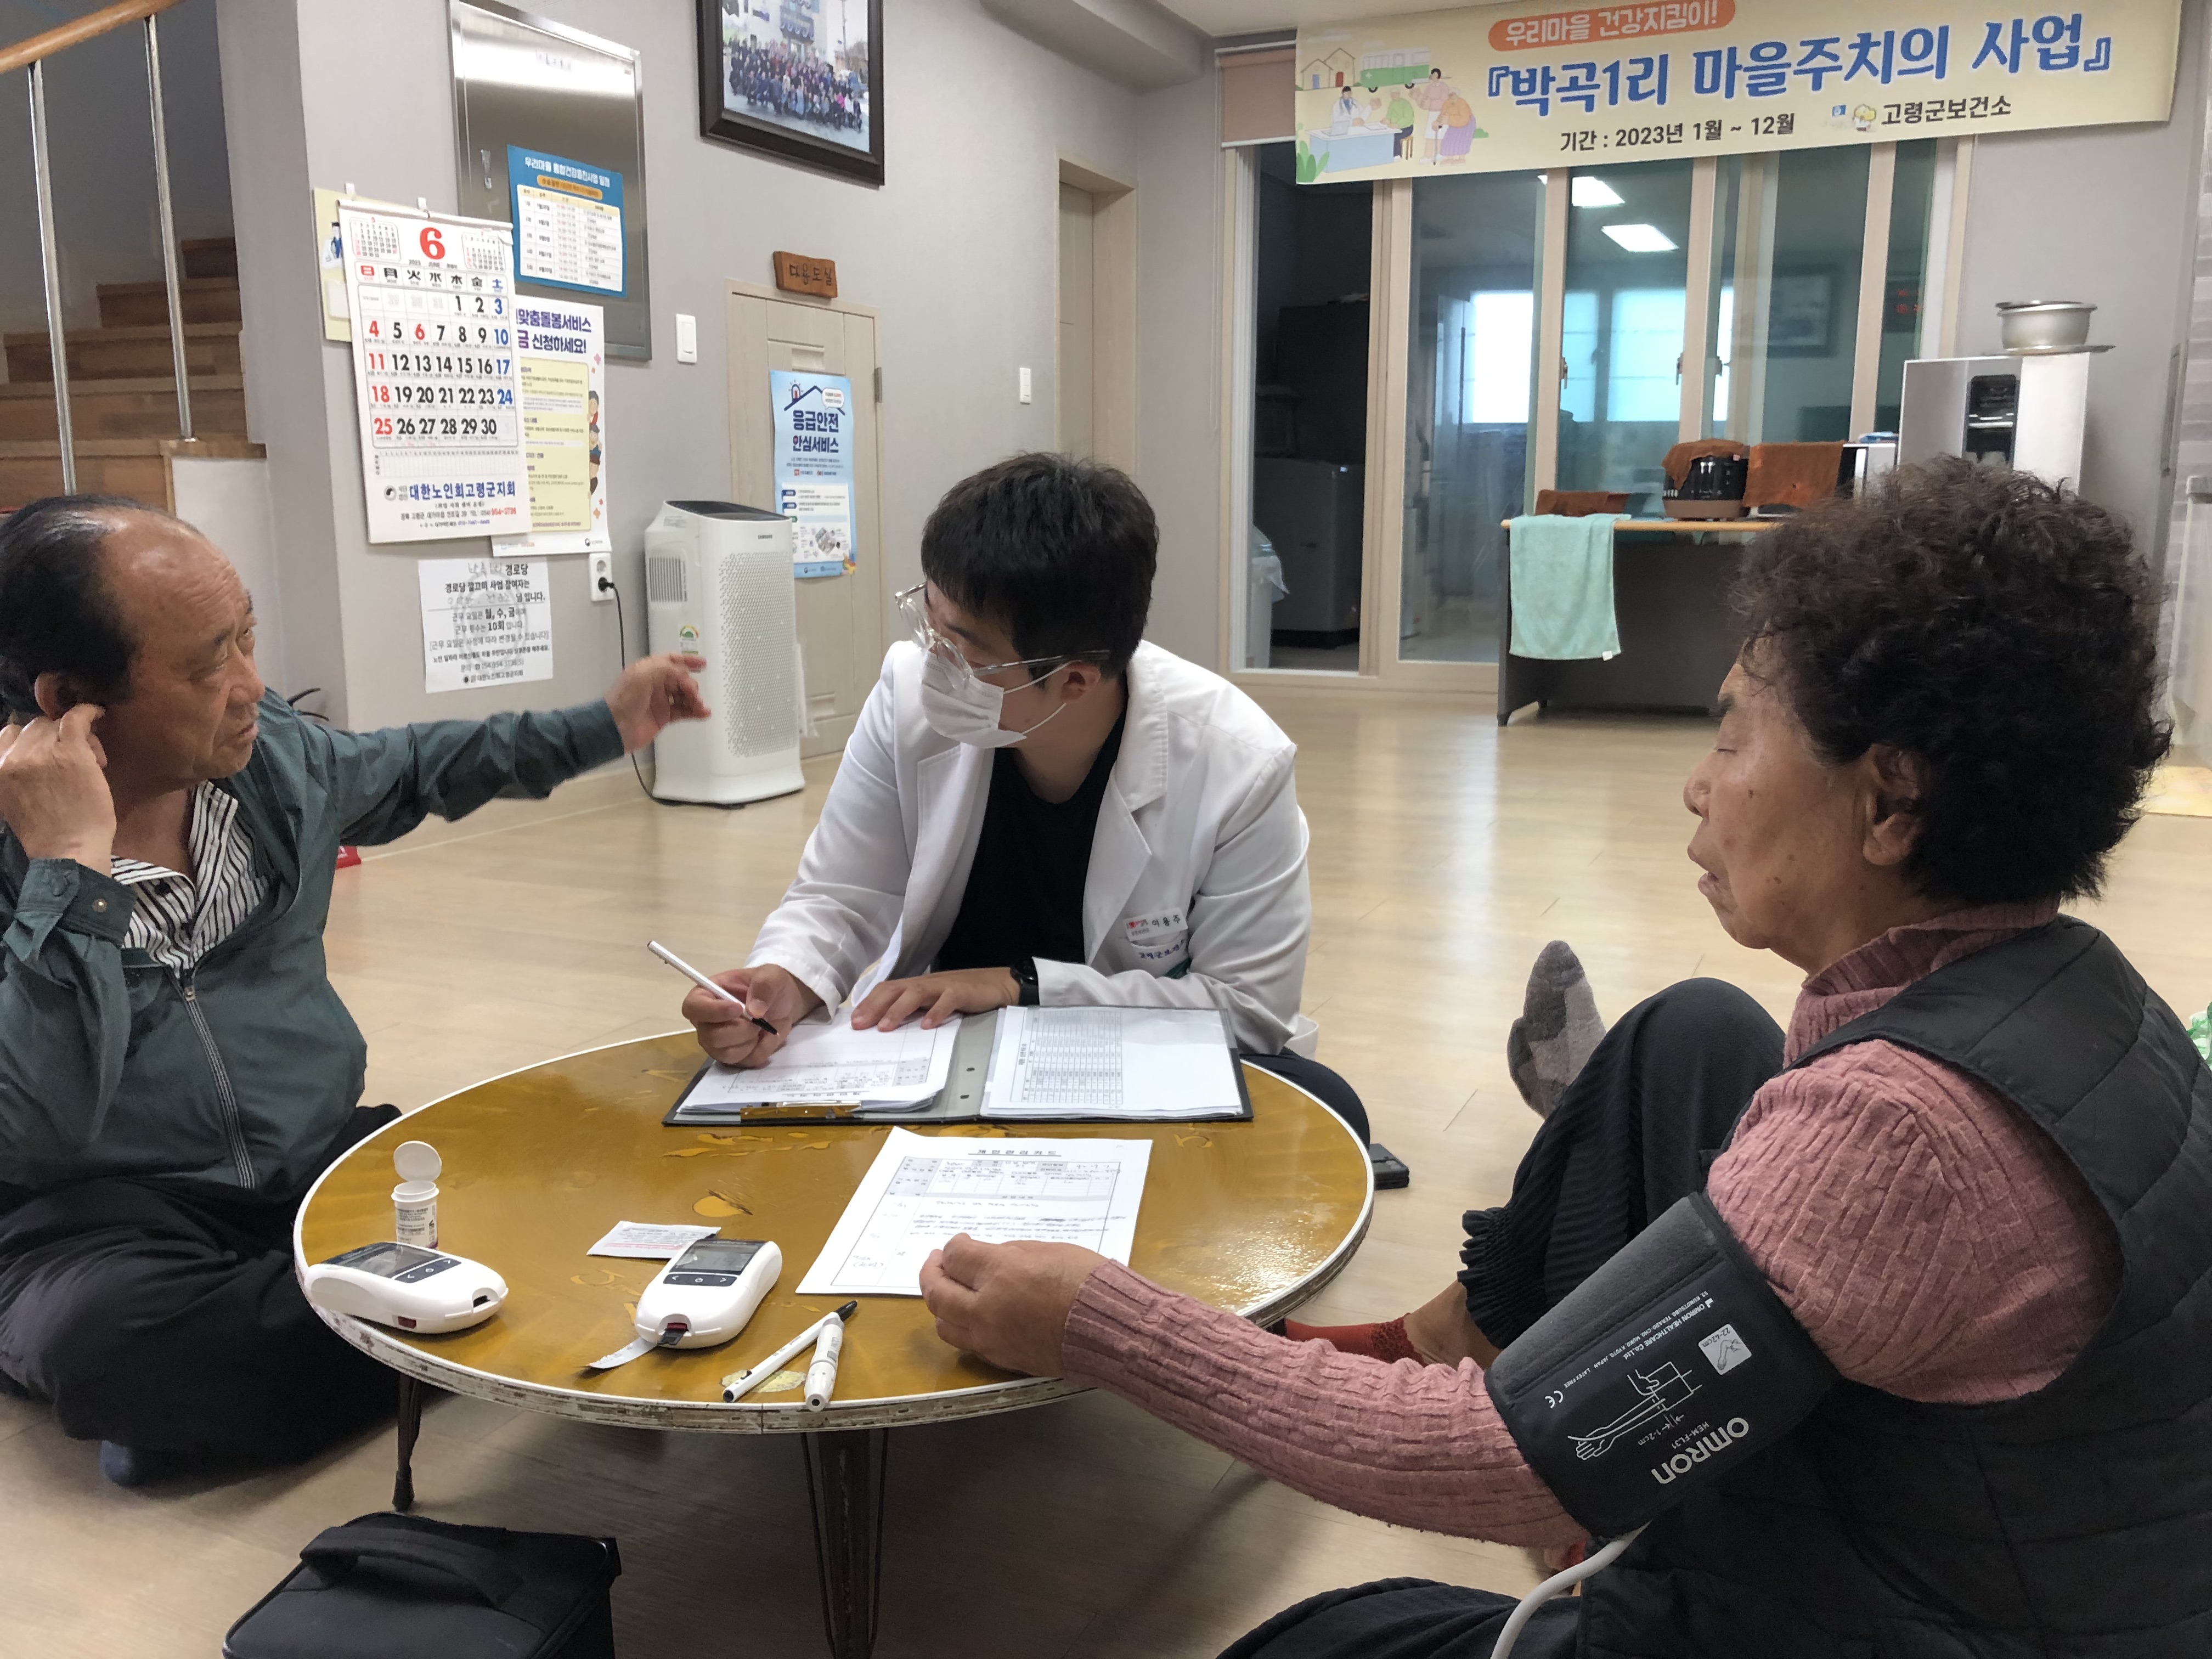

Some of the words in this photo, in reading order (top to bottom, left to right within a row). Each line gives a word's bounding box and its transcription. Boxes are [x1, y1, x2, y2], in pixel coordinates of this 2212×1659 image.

[1505, 15, 1591, 44] 우리마을
[1598, 2, 1718, 38] 건강지킴이!
[1488, 54, 1669, 117] 『박곡1리
[1694, 25, 1949, 99] 마을주치의
[1972, 13, 2112, 74] 사업』
[1881, 95, 2012, 126] 고령군보건소
[1561, 129, 1596, 151] 기간
[1616, 117, 1683, 148] 2023년
[1694, 119, 1723, 142] 1월
[1751, 113, 1795, 136] 12월
[419, 227, 445, 260] 6
[360, 266, 375, 276] 日
[384, 268, 398, 278] 月
[407, 269, 421, 281] 火
[430, 272, 442, 283] 水
[450, 274, 462, 285] 木
[492, 279, 503, 289] 土
[788, 263, 832, 286] 다용도실
[455, 296, 461, 311] 1
[475, 297, 484, 313] 2
[494, 298, 503, 314] 3
[516, 308, 591, 332] 맞춤돌봄서비스
[369, 321, 379, 337] 4
[393, 322, 402, 338] 5
[415, 324, 425, 340] 6
[437, 325, 445, 341] 7
[458, 326, 467, 342] 8
[478, 328, 487, 343] 9
[494, 329, 510, 345] 10
[532, 334, 586, 354] 신청하세요!
[369, 353, 384, 370] 11
[392, 354, 410, 371] 12
[415, 355, 433, 372] 13
[436, 356, 453, 373] 14
[457, 357, 472, 374] 15
[477, 358, 493, 374] 16
[496, 359, 510, 375] 17
[372, 386, 390, 403] 18
[394, 386, 412, 403] 19
[416, 387, 434, 403] 20
[438, 387, 453, 404] 21
[458, 388, 475, 404] 22
[478, 388, 494, 405] 23
[497, 389, 513, 405] 24
[374, 417, 392, 435] 25
[397, 418, 415, 435] 26
[419, 418, 436, 435] 27
[440, 418, 457, 435] 28
[461, 419, 477, 434] 29
[481, 419, 496, 435] 30
[792, 410, 839, 433] 응급안전
[793, 435, 839, 453] 안심서비스
[409, 481, 515, 501] 대한노인회고령군지회
[505, 563, 528, 576] 경로당
[445, 583, 466, 594] 경로당
[1681, 1304, 1705, 1322] OMRON
[1643, 1318, 1683, 1347] HEALTHCARE
[1702, 1327, 1731, 1348] 22-42cm
[1593, 1356, 1609, 1369] JAPAN
[1564, 1378, 1577, 1389] FREE
[1575, 1368, 1591, 1380] LATEX
[1637, 1429, 1662, 1446] 1-2cm
[1671, 1421, 1710, 1449] HEM-FL31
